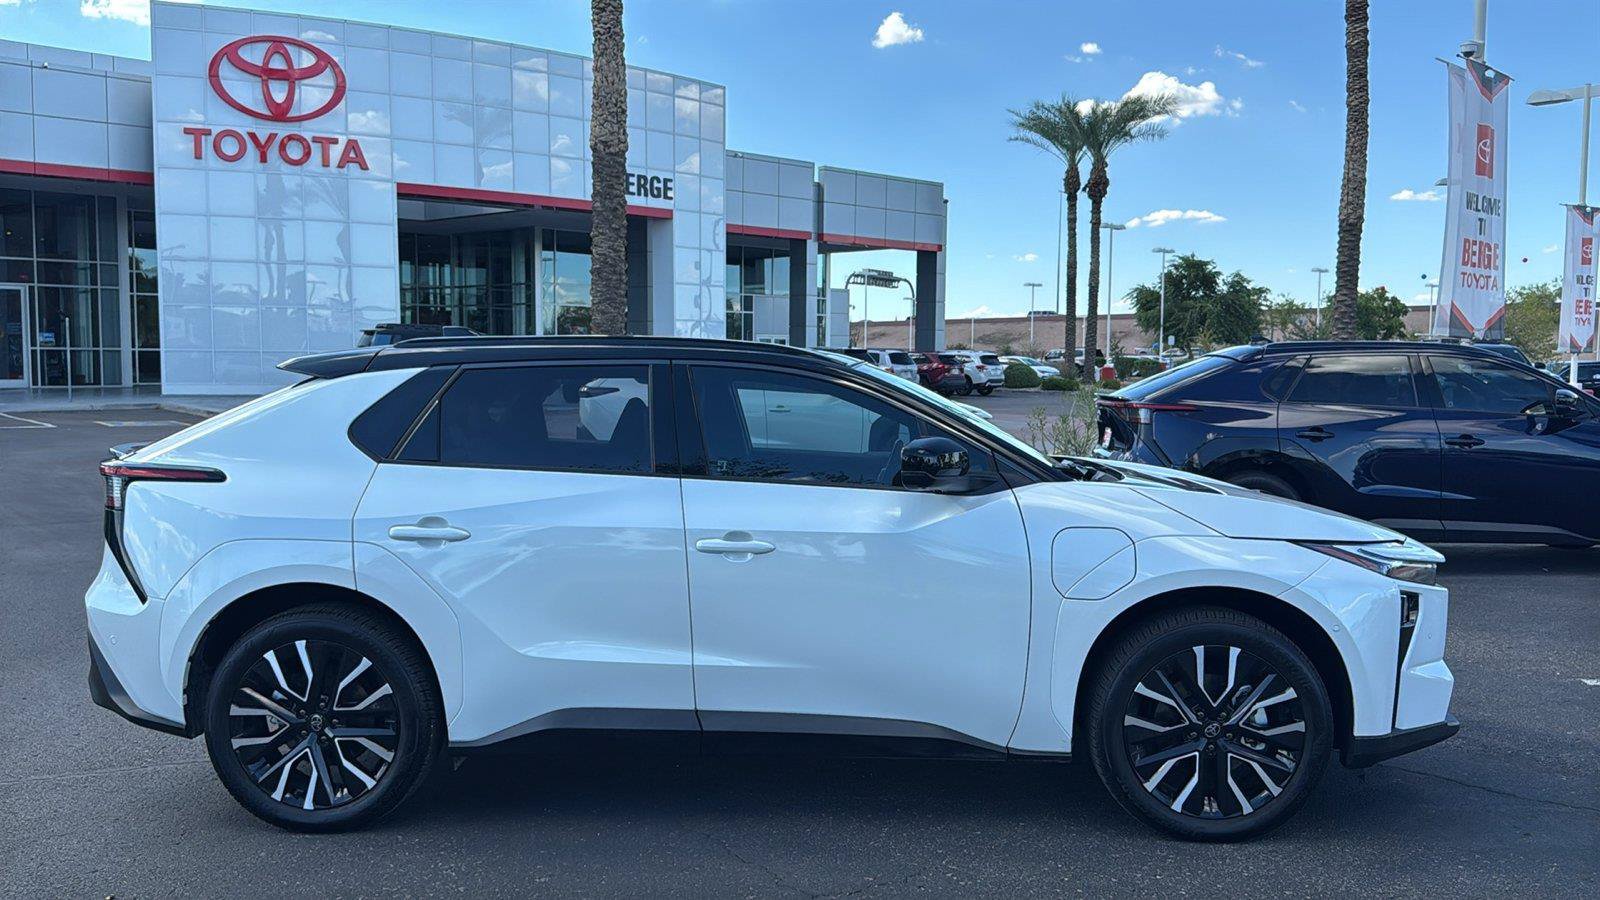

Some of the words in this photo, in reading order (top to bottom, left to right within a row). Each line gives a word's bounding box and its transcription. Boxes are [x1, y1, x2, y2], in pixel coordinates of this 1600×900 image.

[183, 127, 370, 171] TOYOTA
[625, 173, 674, 200] ERGE
[1461, 272, 1498, 290] TOYOTA
